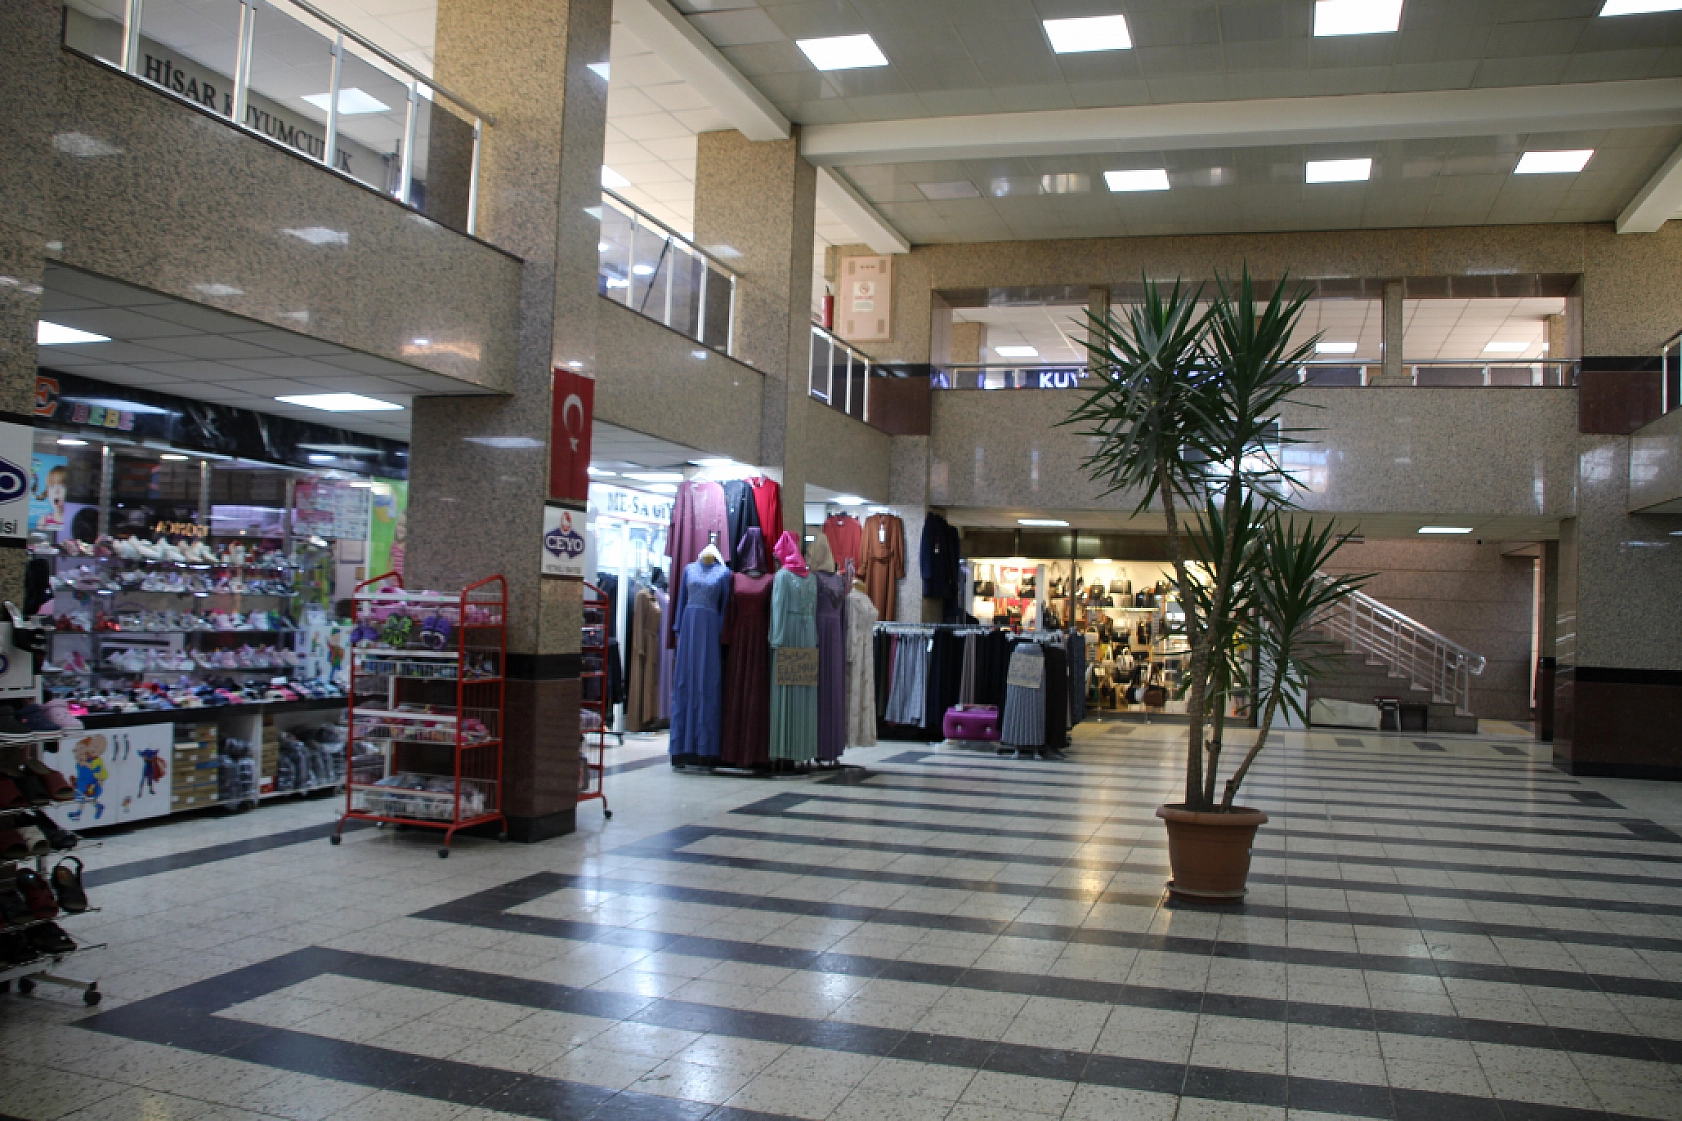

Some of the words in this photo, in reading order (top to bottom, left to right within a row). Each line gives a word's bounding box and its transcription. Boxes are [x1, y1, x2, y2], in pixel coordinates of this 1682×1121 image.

[144, 53, 216, 110] HİSAR
[71, 403, 136, 431] BEBE
[545, 535, 583, 552] CEYO
